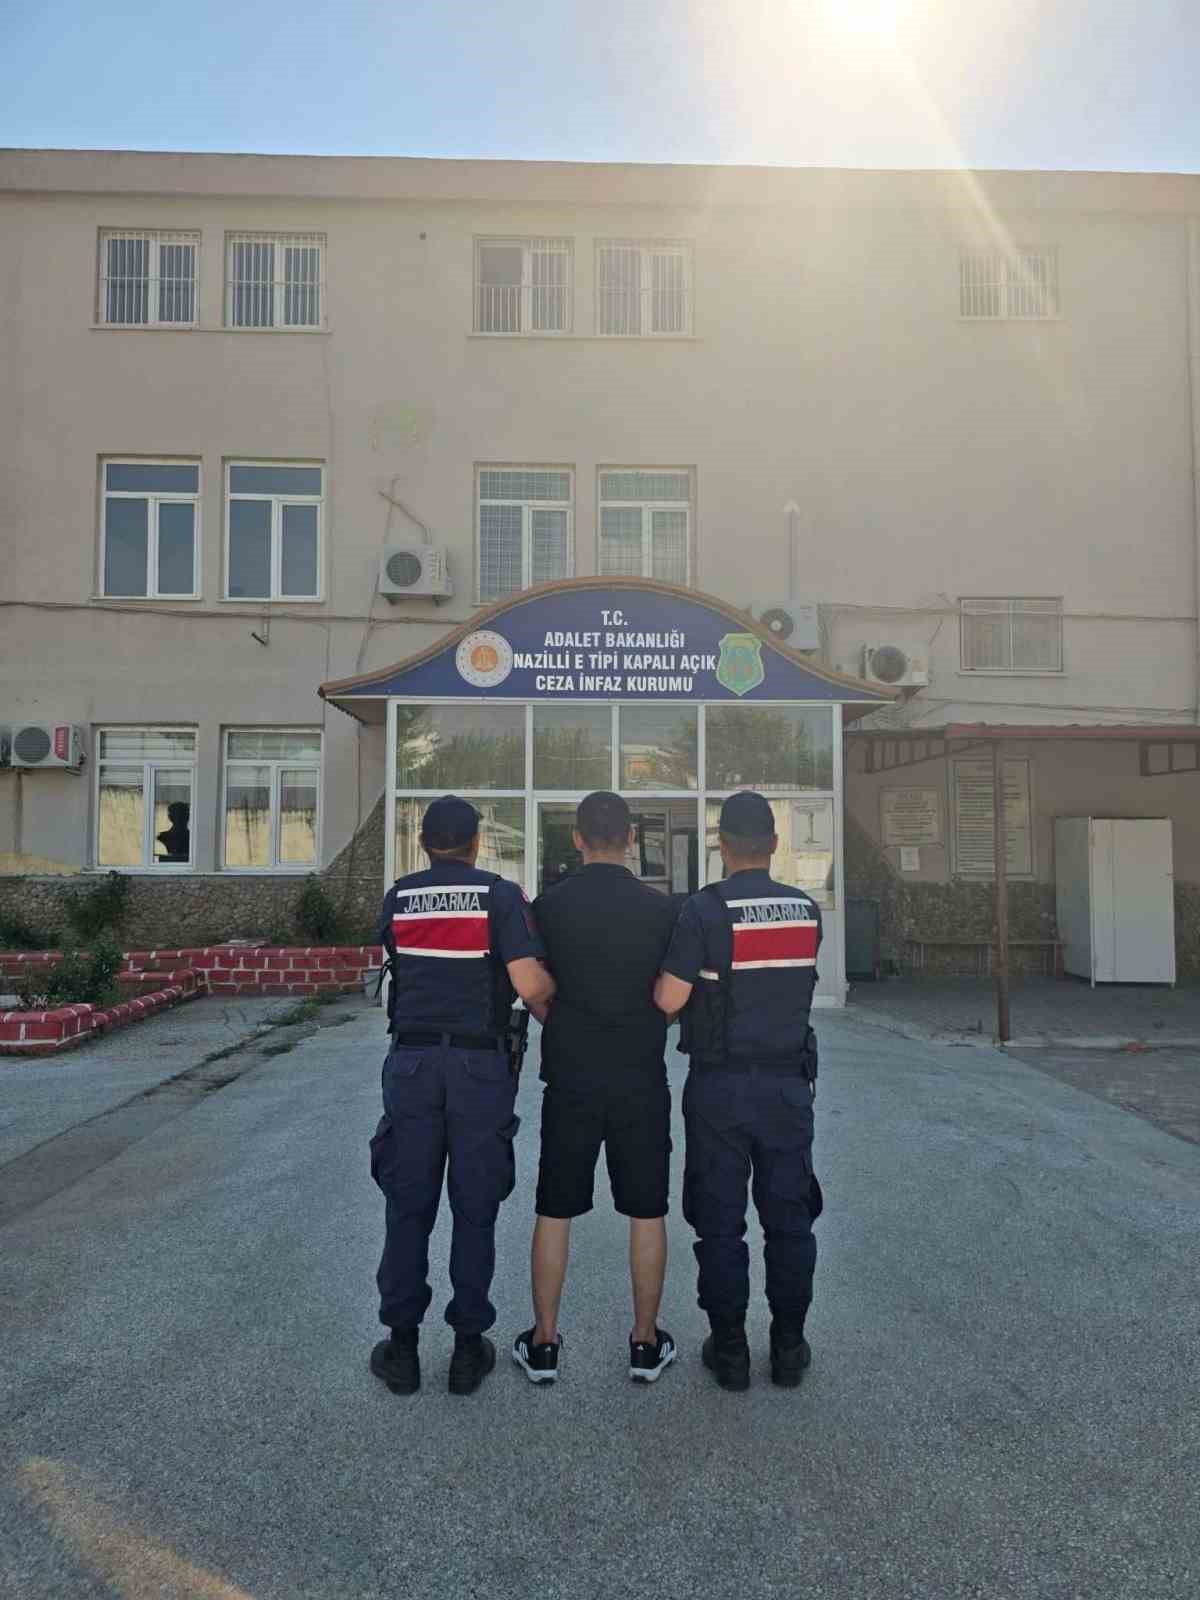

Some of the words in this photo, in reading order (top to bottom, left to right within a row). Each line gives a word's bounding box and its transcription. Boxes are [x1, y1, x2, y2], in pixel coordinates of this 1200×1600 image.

[601, 610, 628, 626] T.C.
[544, 631, 600, 648] ADALET
[605, 629, 685, 649] BAKANLIĞI
[513, 652, 570, 670] NAZİLLİ
[574, 654, 584, 670] E
[588, 653, 618, 670] TİPİ
[623, 654, 675, 670] KAPALI
[680, 654, 717, 675] AÇIK
[535, 675, 574, 691] CEZA
[579, 672, 623, 691] İNFAZ
[627, 676, 693, 692] KURUMU
[403, 893, 481, 914] JANDARMA
[740, 904, 810, 923] JANDARMA
